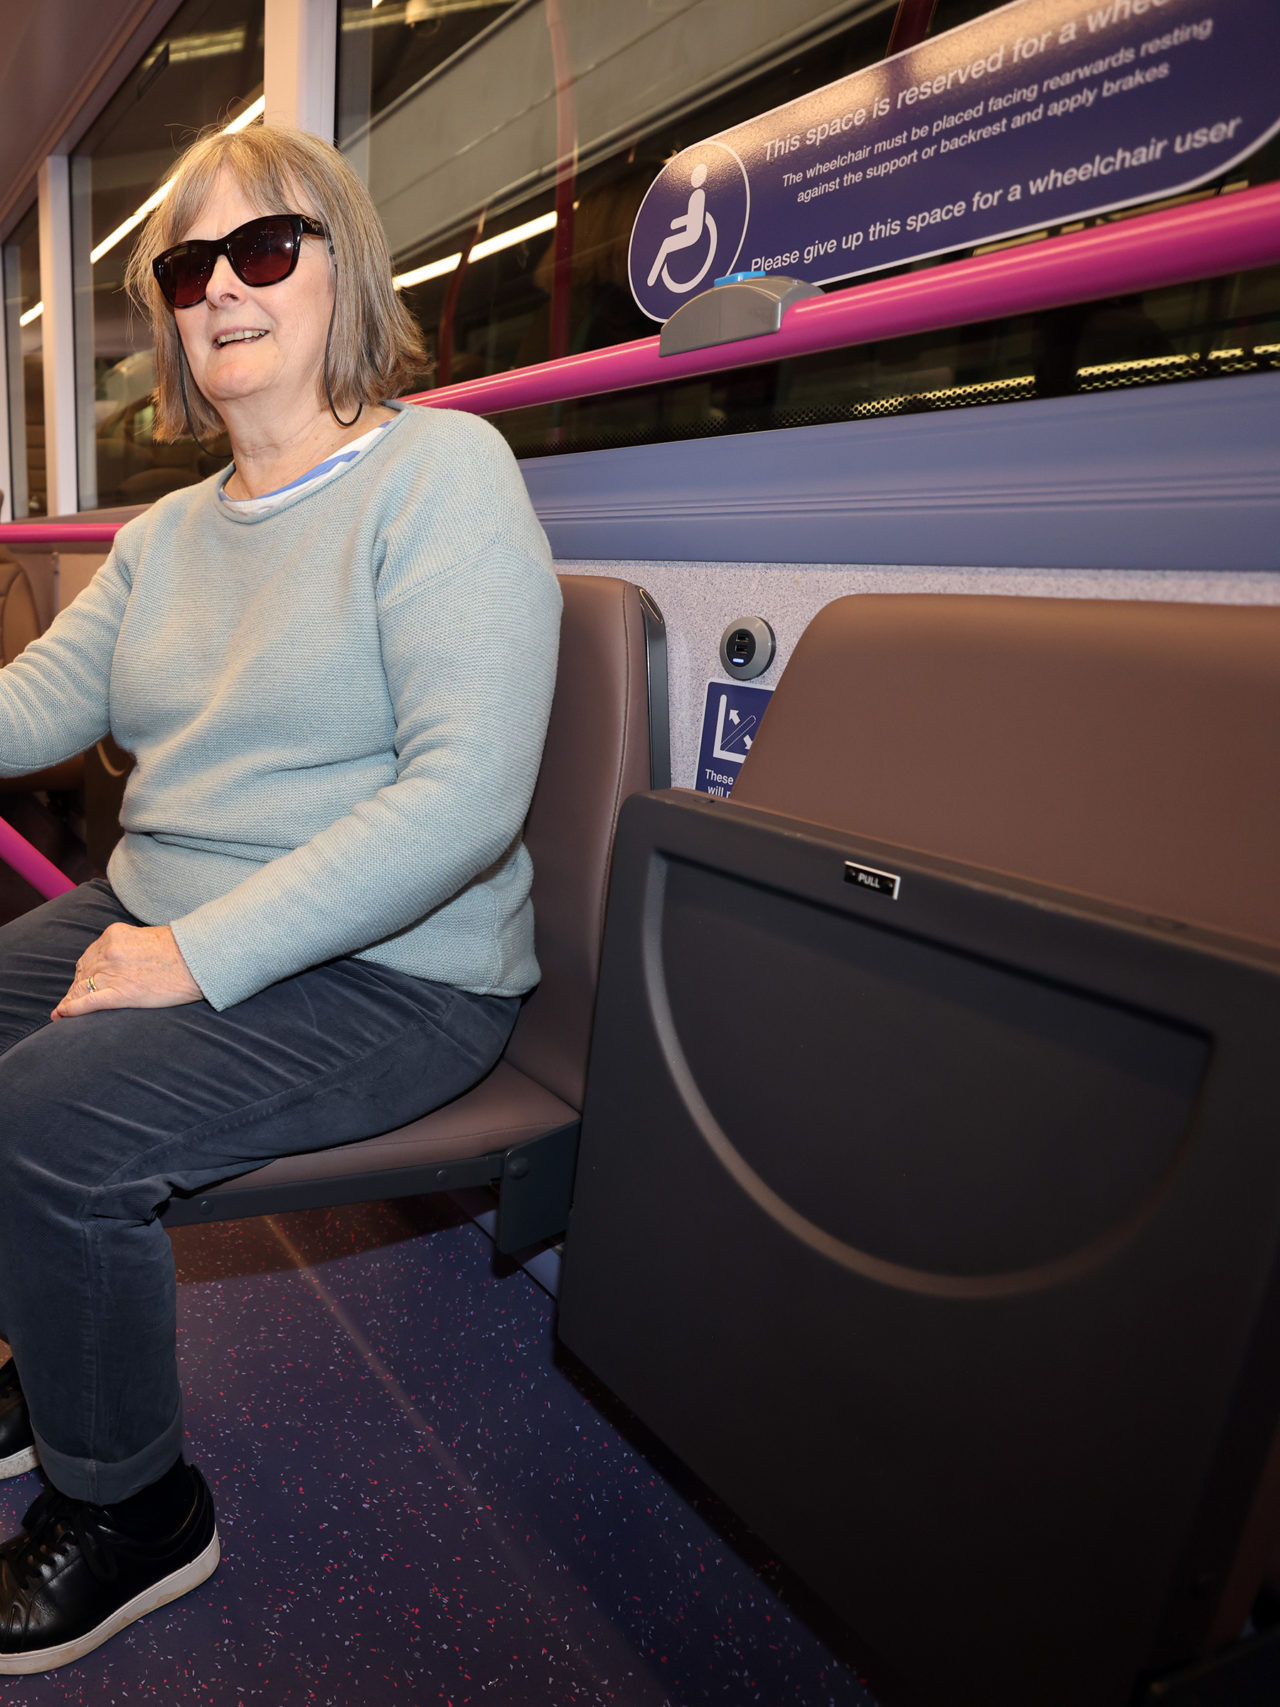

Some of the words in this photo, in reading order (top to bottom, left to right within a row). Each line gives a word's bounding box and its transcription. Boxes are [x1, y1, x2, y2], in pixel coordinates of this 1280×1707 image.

[764, 134, 800, 161] This
[805, 108, 866, 146] space
[872, 96, 891, 119] is
[897, 49, 1003, 109] reserved
[1012, 30, 1052, 63] for
[1058, 21, 1077, 44] a
[782, 168, 803, 188] The
[806, 145, 872, 179] wheelchair
[874, 130, 908, 155] must
[910, 124, 929, 141] be
[932, 102, 984, 139] placed
[988, 84, 1038, 113] facing
[1042, 48, 1135, 93] rearwards
[1140, 17, 1214, 57] resting
[797, 176, 840, 203] against
[843, 170, 863, 187] the
[866, 151, 918, 179] support
[921, 144, 937, 160] or
[939, 117, 1007, 154] backrest
[1010, 104, 1044, 128] and
[1047, 86, 1098, 117] apply
[1101, 61, 1170, 98] brakes
[751, 249, 800, 273] Please
[803, 236, 837, 264] give
[842, 231, 863, 250] up
[868, 218, 901, 242] this
[906, 200, 966, 232] space
[972, 188, 1003, 212] for
[1007, 183, 1022, 202] a
[1029, 137, 1169, 196] wheelchair
[1173, 116, 1243, 154] user
[705, 768, 734, 785] These
[707, 785, 725, 798] will
[857, 872, 880, 888] PULL
